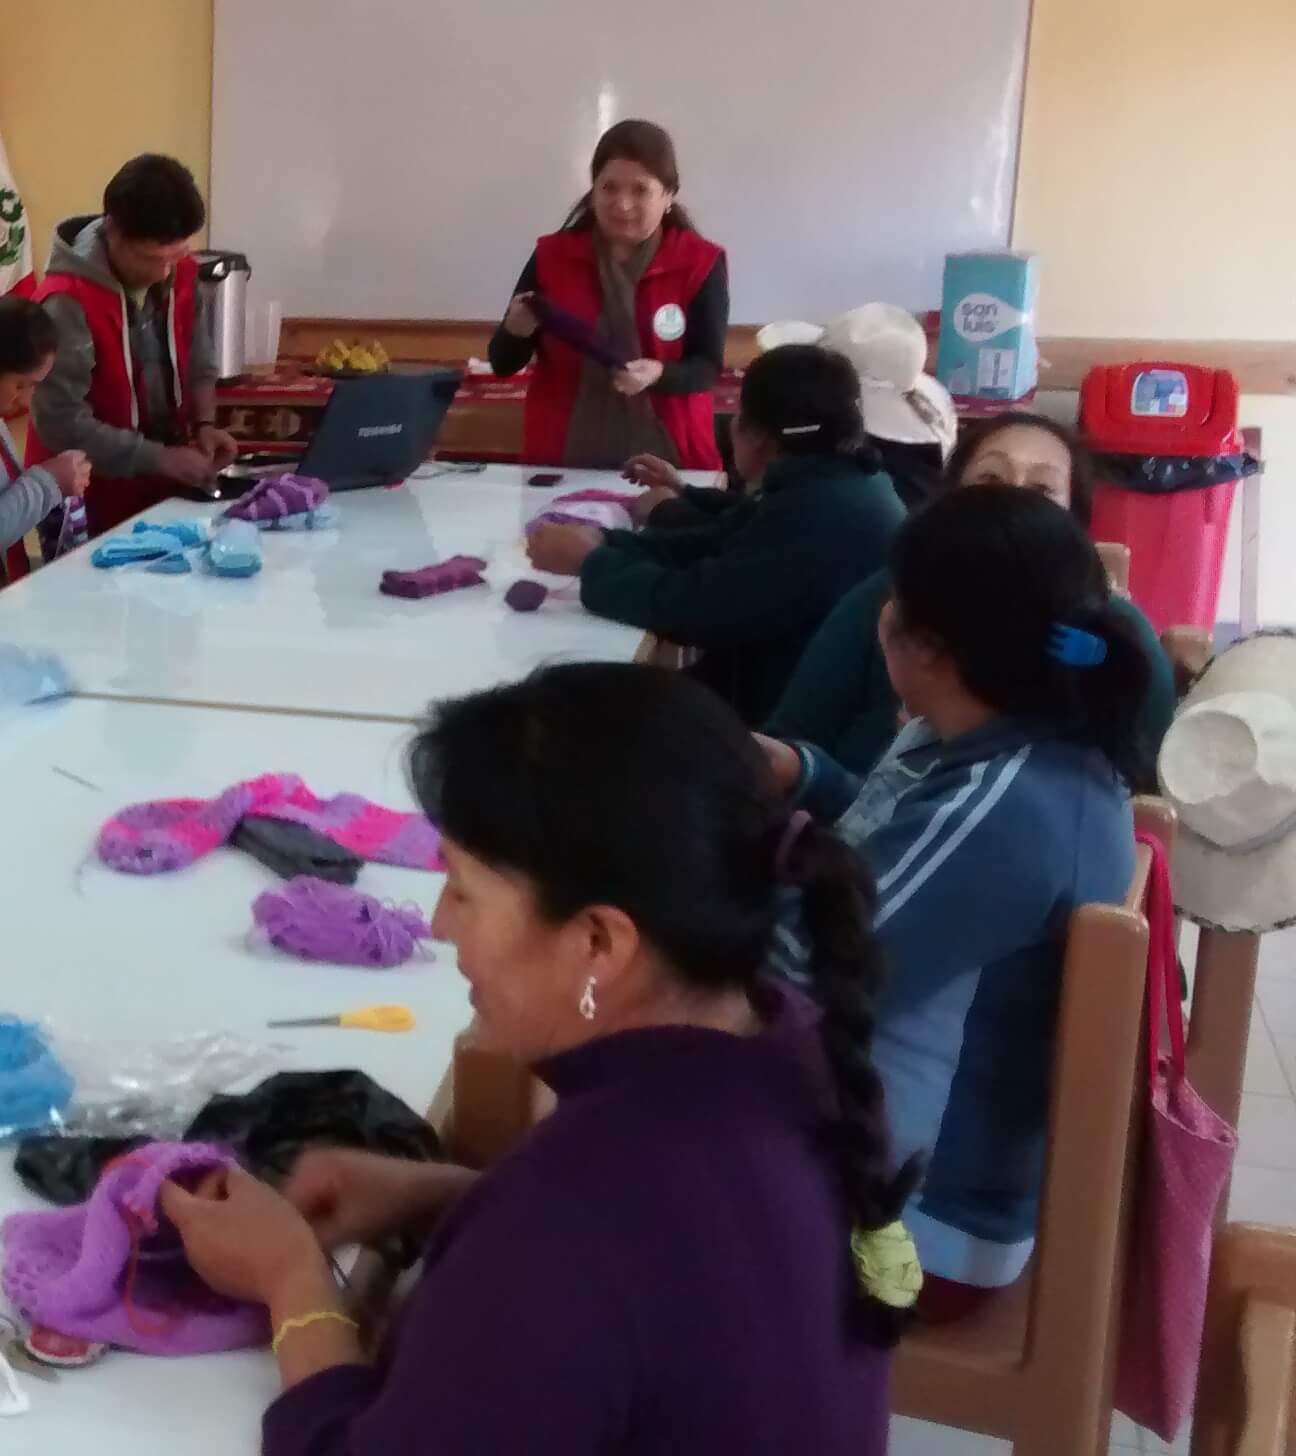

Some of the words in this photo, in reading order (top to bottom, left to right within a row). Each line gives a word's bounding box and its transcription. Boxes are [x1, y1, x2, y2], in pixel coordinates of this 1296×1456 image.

[961, 303, 998, 316] san
[962, 319, 996, 333] luis
[358, 423, 403, 437] TOSHIBA
